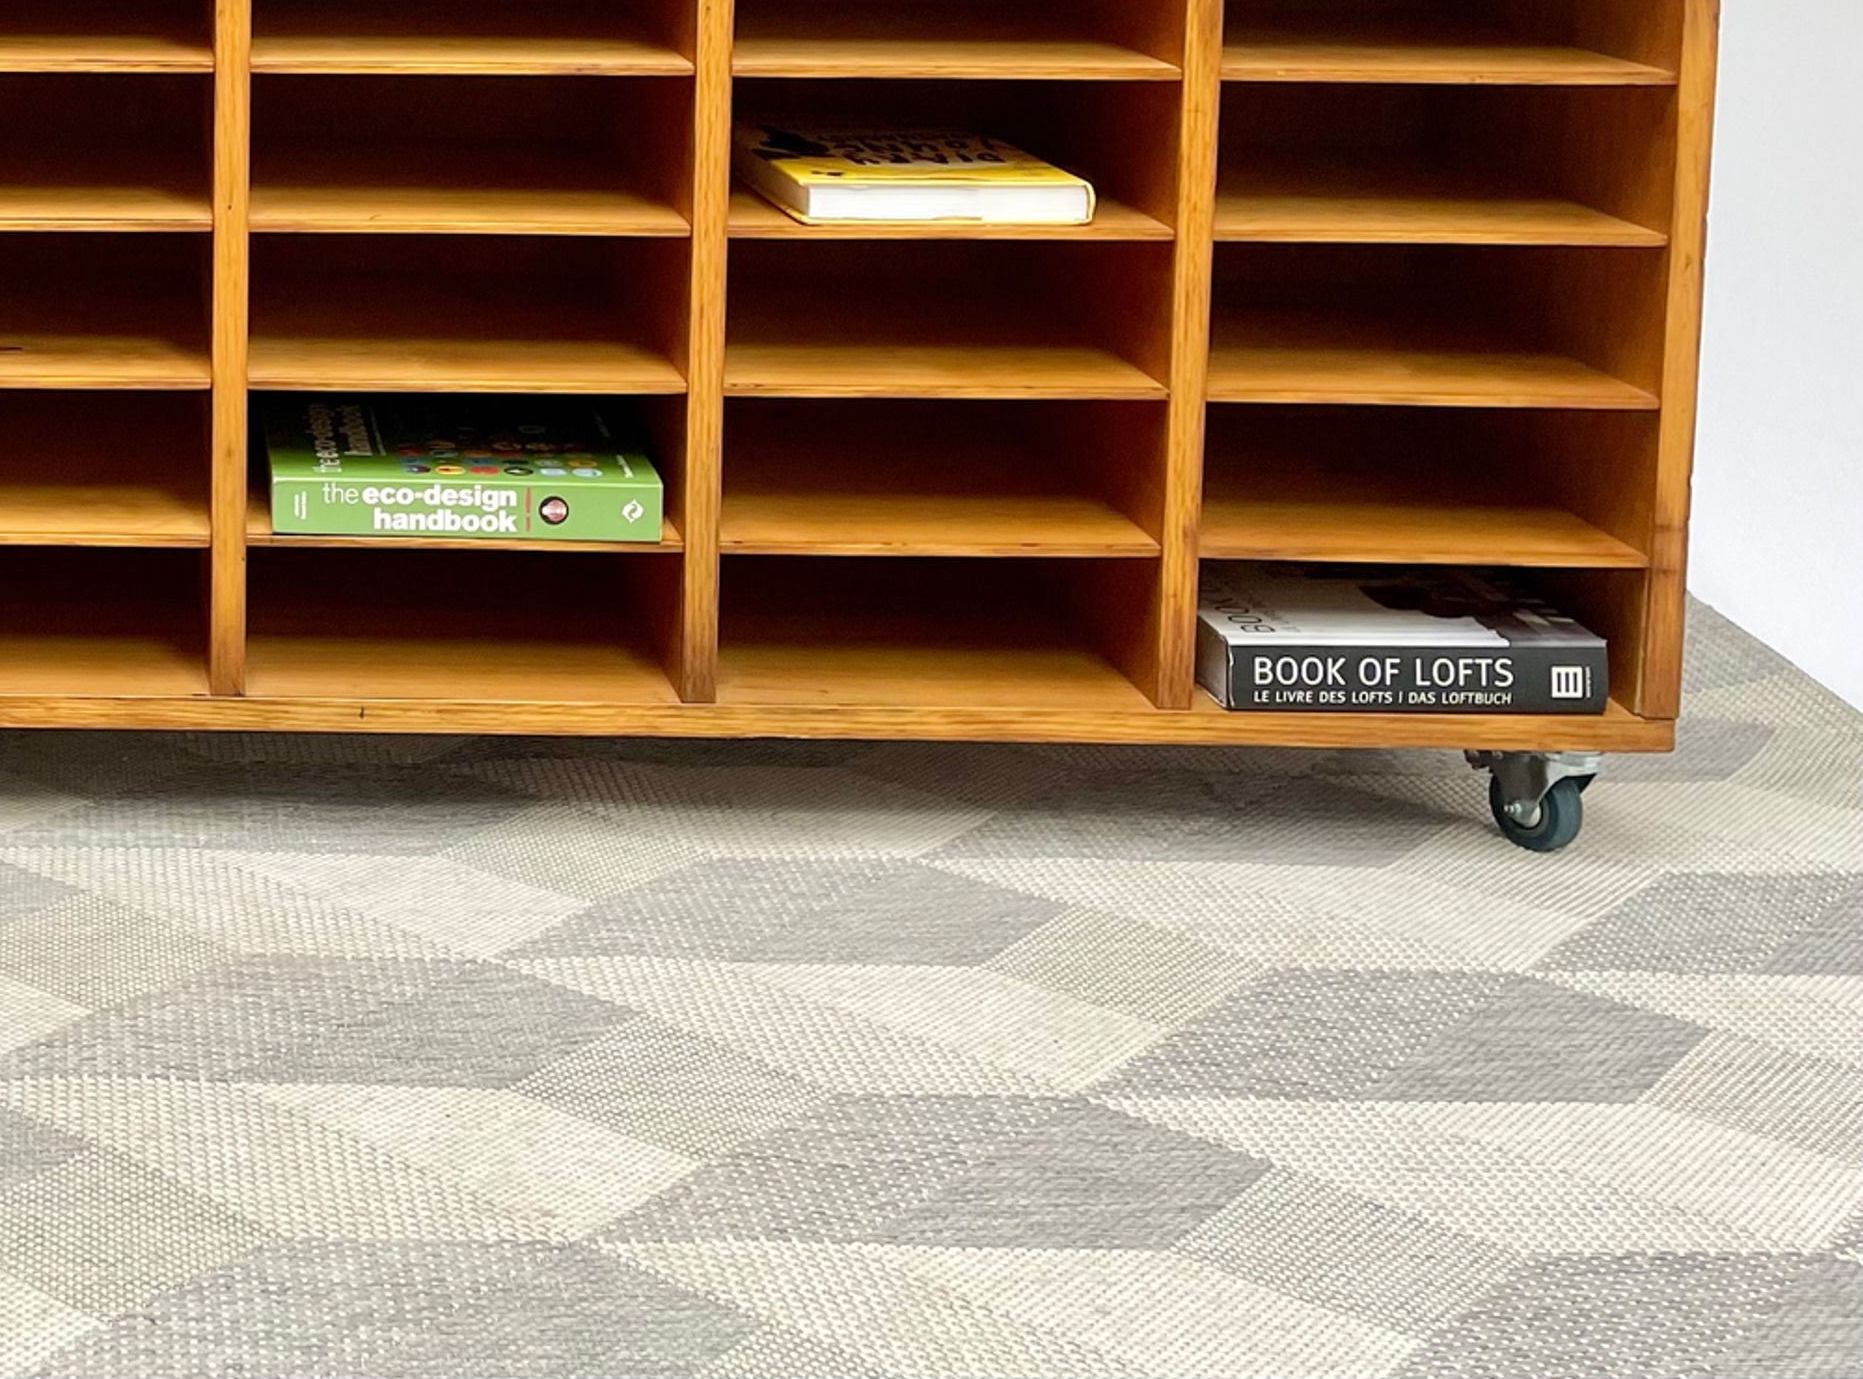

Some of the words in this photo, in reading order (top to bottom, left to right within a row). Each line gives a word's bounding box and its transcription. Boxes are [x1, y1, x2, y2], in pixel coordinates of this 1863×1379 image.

[322, 483, 359, 504] the
[362, 483, 517, 512] eco-design
[374, 507, 518, 532] handbook
[1253, 656, 1347, 686] BOOK
[1358, 657, 1402, 686] OF
[1415, 657, 1515, 688] LOFTS
[1253, 690, 1270, 703] LE
[1275, 690, 1313, 704] LIVRE
[1319, 690, 1346, 704] DES
[1351, 691, 1393, 705] LOFTS
[1408, 691, 1436, 705] DAS
[1441, 691, 1513, 705] LOFTBUCH
